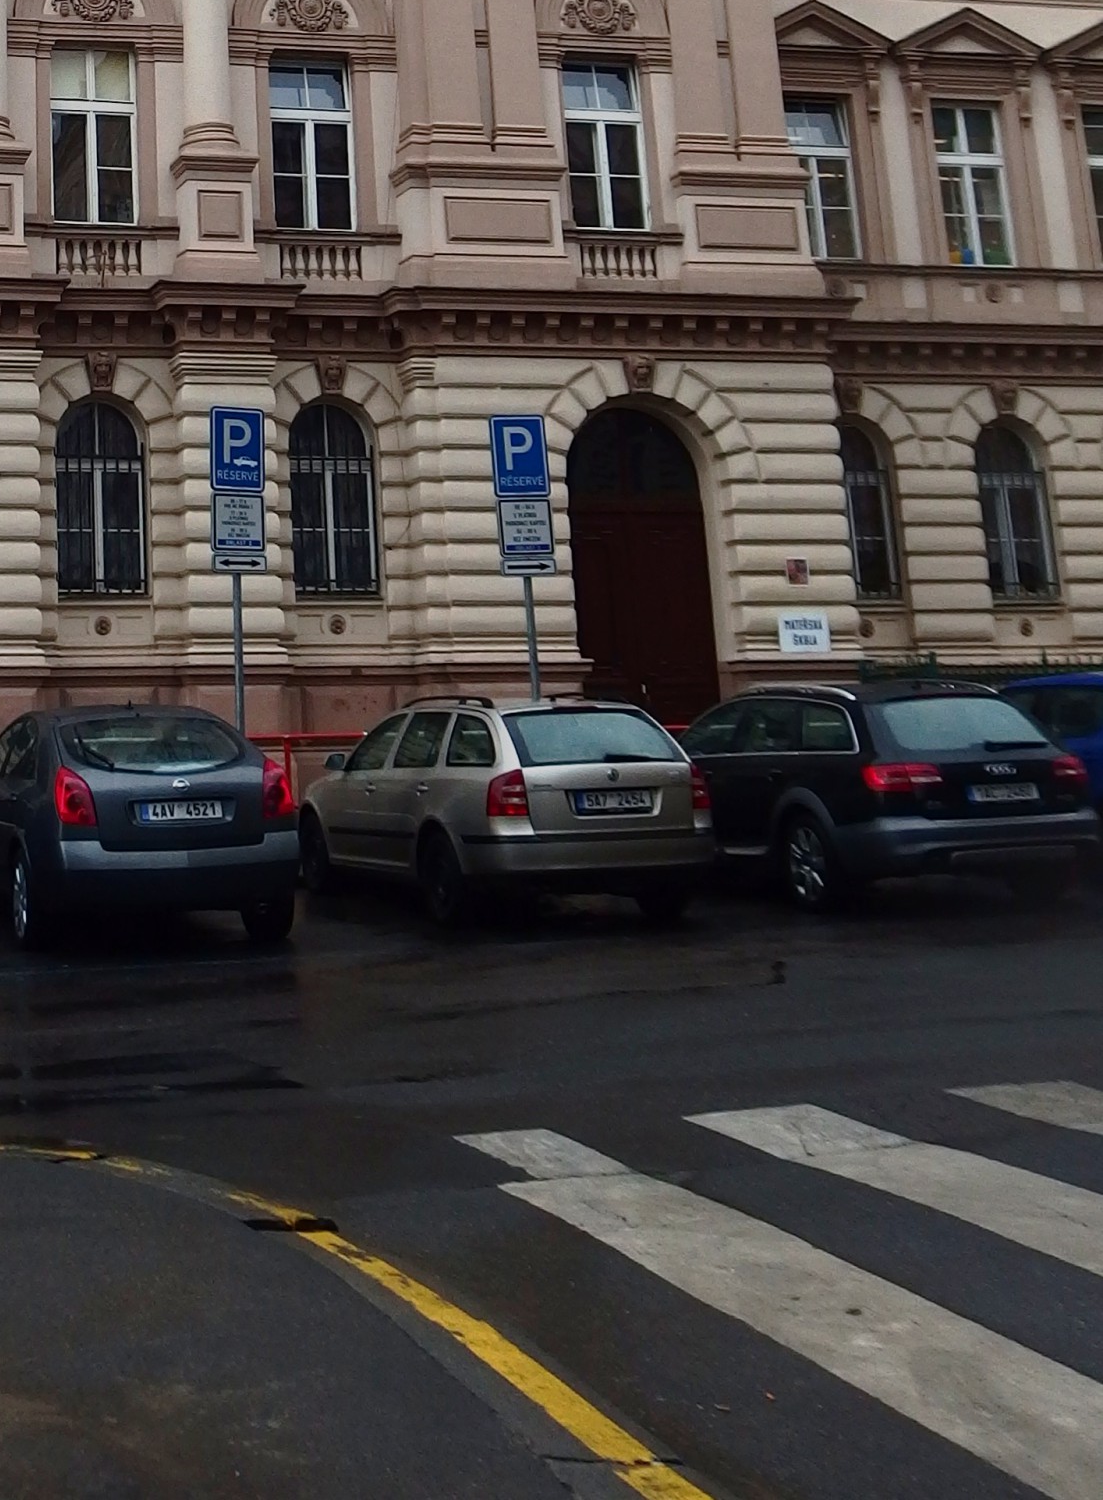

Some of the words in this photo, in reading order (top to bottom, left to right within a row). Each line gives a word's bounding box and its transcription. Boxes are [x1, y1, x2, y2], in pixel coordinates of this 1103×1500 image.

[223, 418, 252, 464] P
[502, 426, 534, 471] P
[793, 633, 818, 646] ŠKOLA
[586, 793, 607, 808] 5A7
[152, 804, 175, 818] 4AV
[186, 802, 217, 817] 4521
